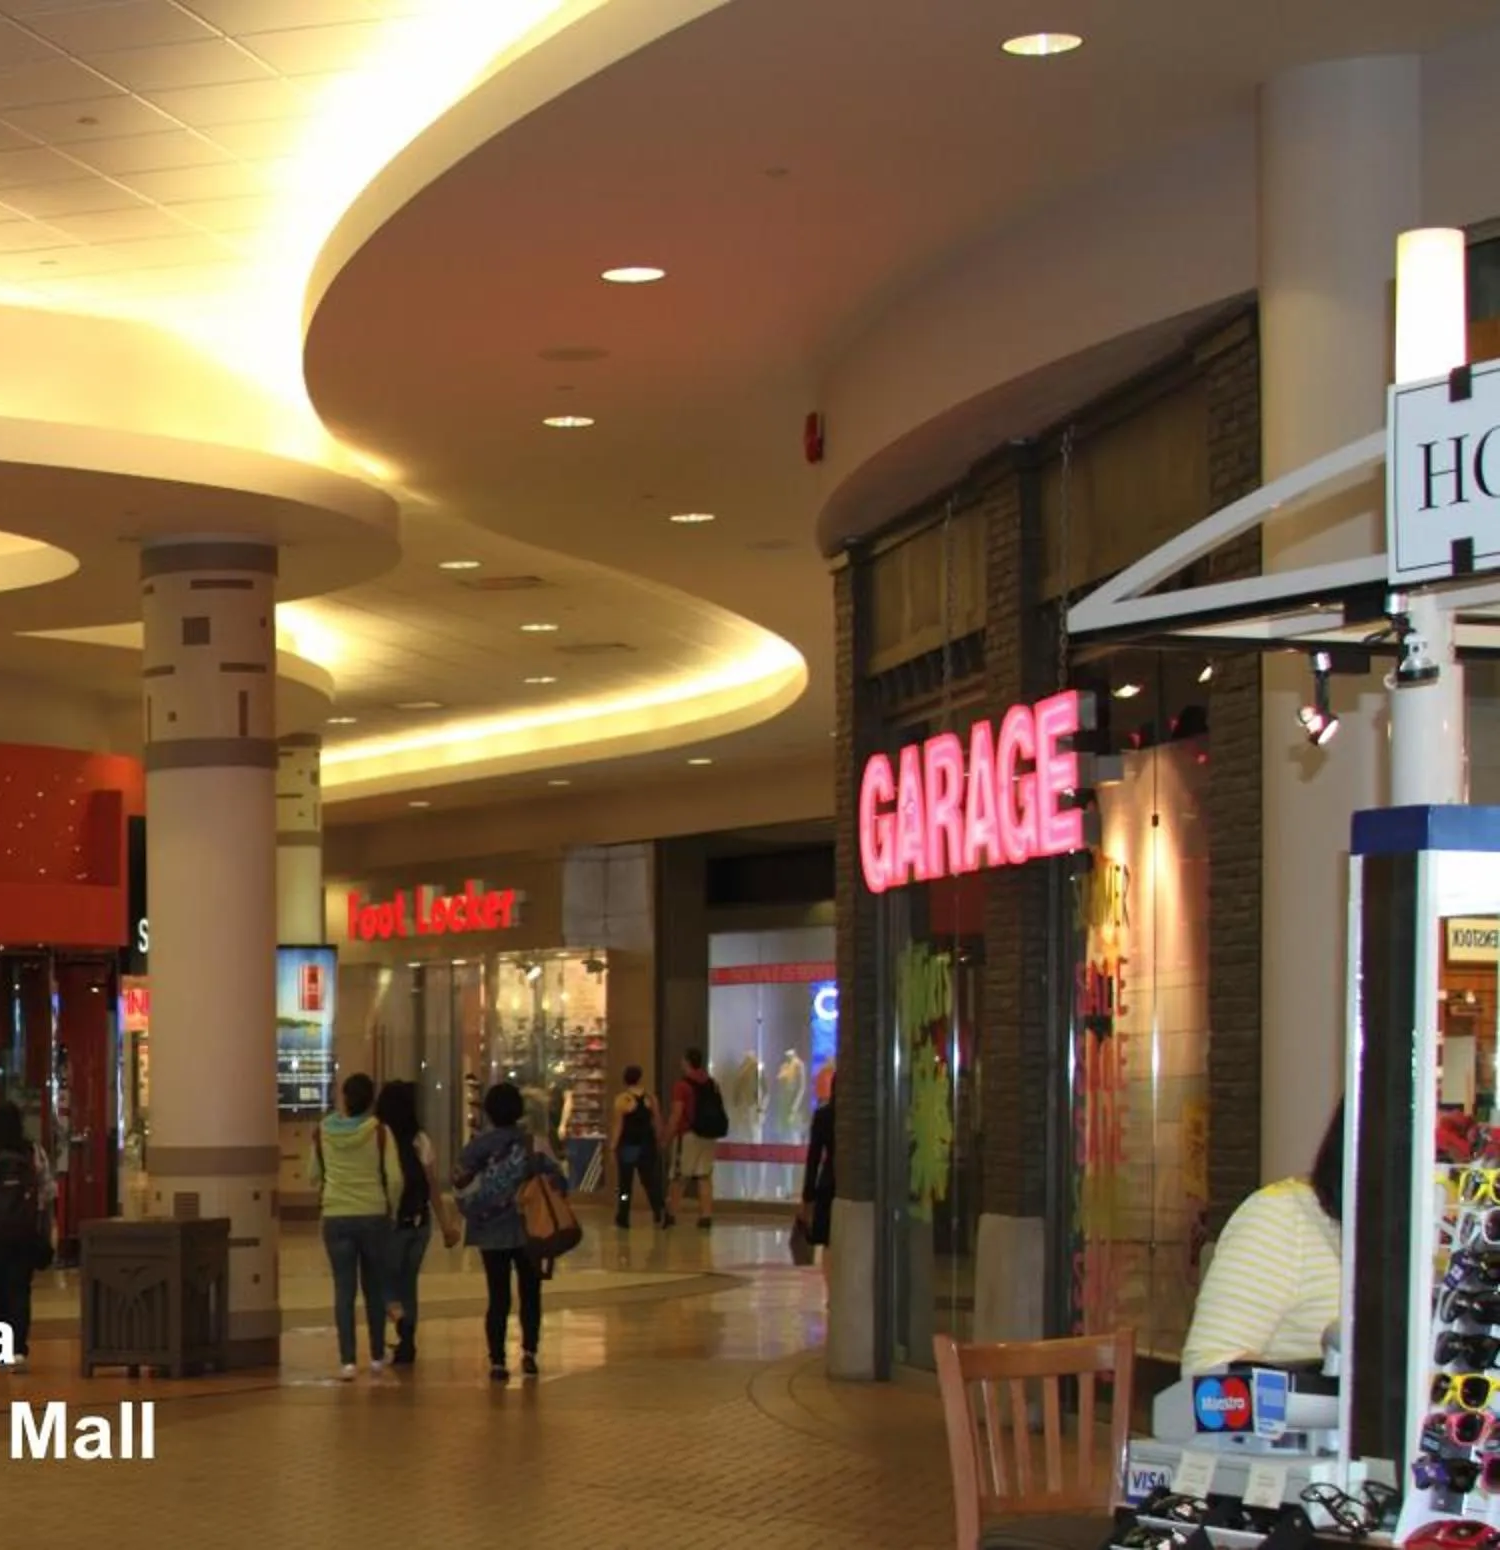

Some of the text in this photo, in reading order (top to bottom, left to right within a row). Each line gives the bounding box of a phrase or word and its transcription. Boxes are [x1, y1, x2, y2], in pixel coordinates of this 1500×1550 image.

[860, 689, 1083, 893] GARAGE
[347, 879, 518, 942] Foot Locker
[1133, 1470, 1166, 1489] VISA
